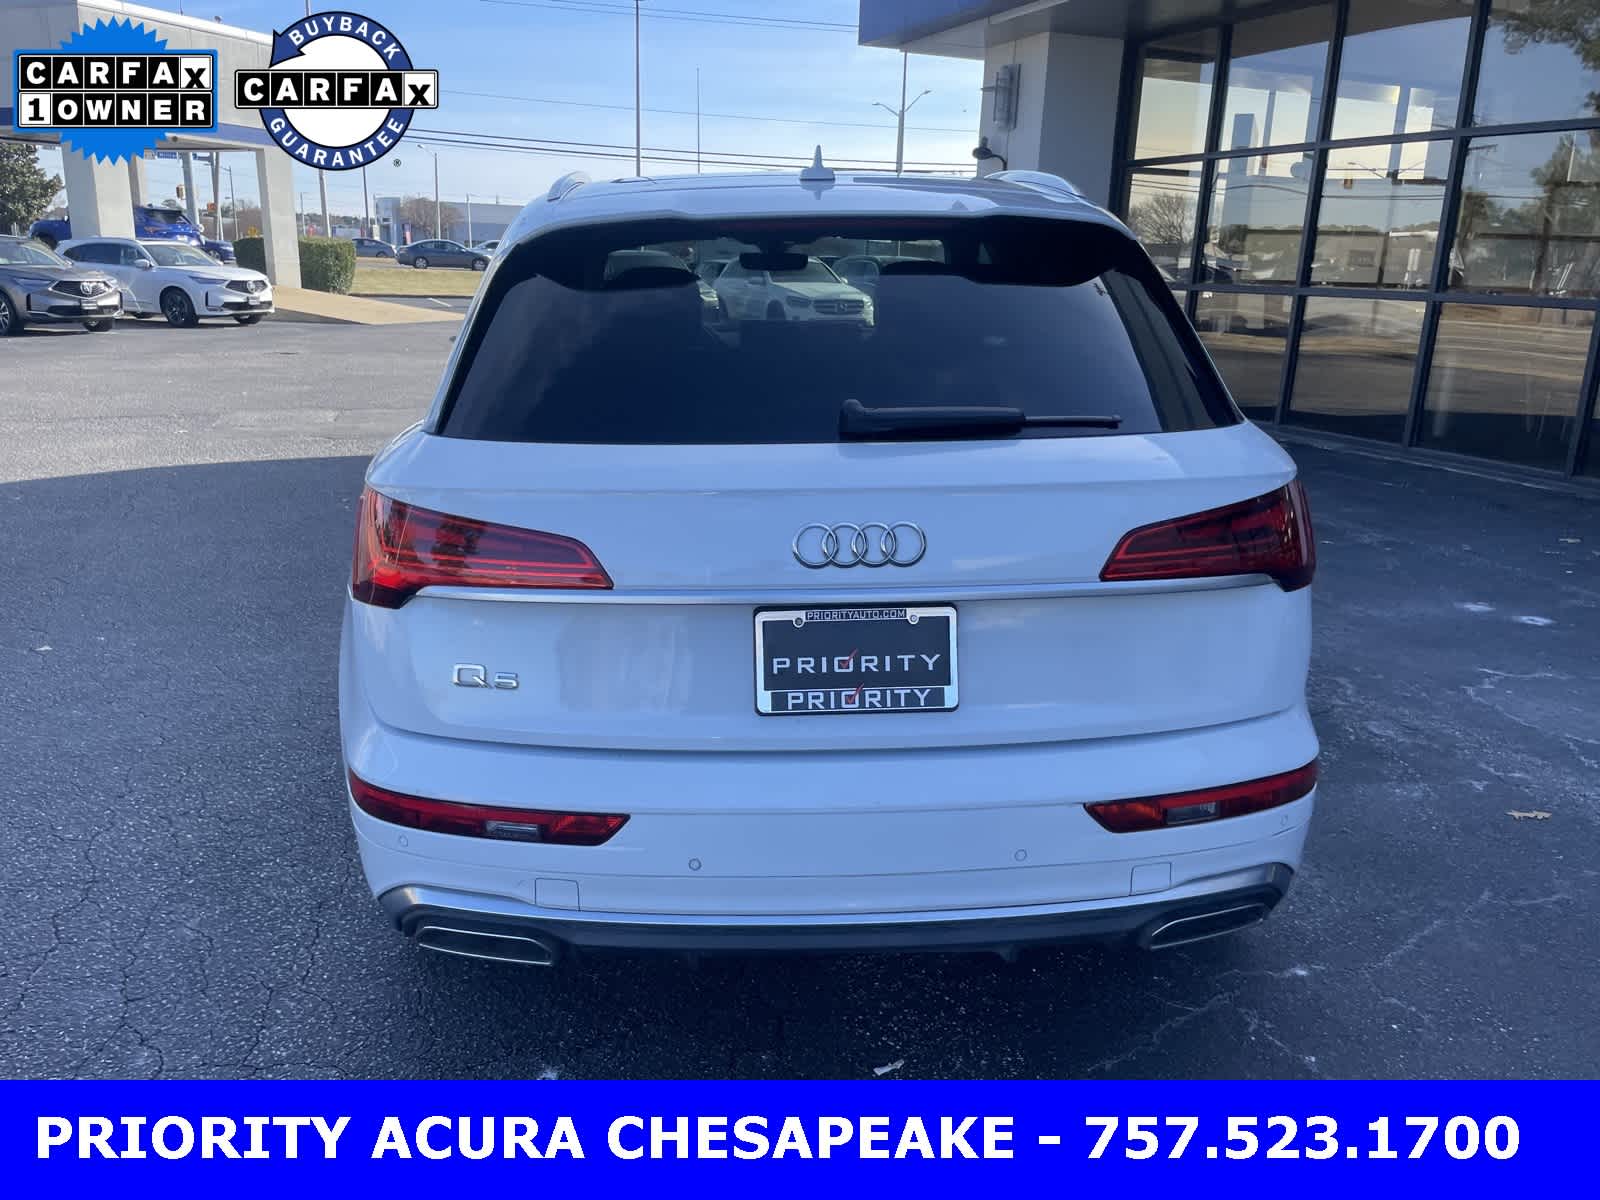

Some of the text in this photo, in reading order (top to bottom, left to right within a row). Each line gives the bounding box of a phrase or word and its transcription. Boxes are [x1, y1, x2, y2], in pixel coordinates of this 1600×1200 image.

[807, 608, 907, 621] PRIORITYAUTO.COM
[772, 653, 941, 674] PRIORITY
[452, 662, 519, 690] Q5
[787, 688, 932, 710] PRIORITY
